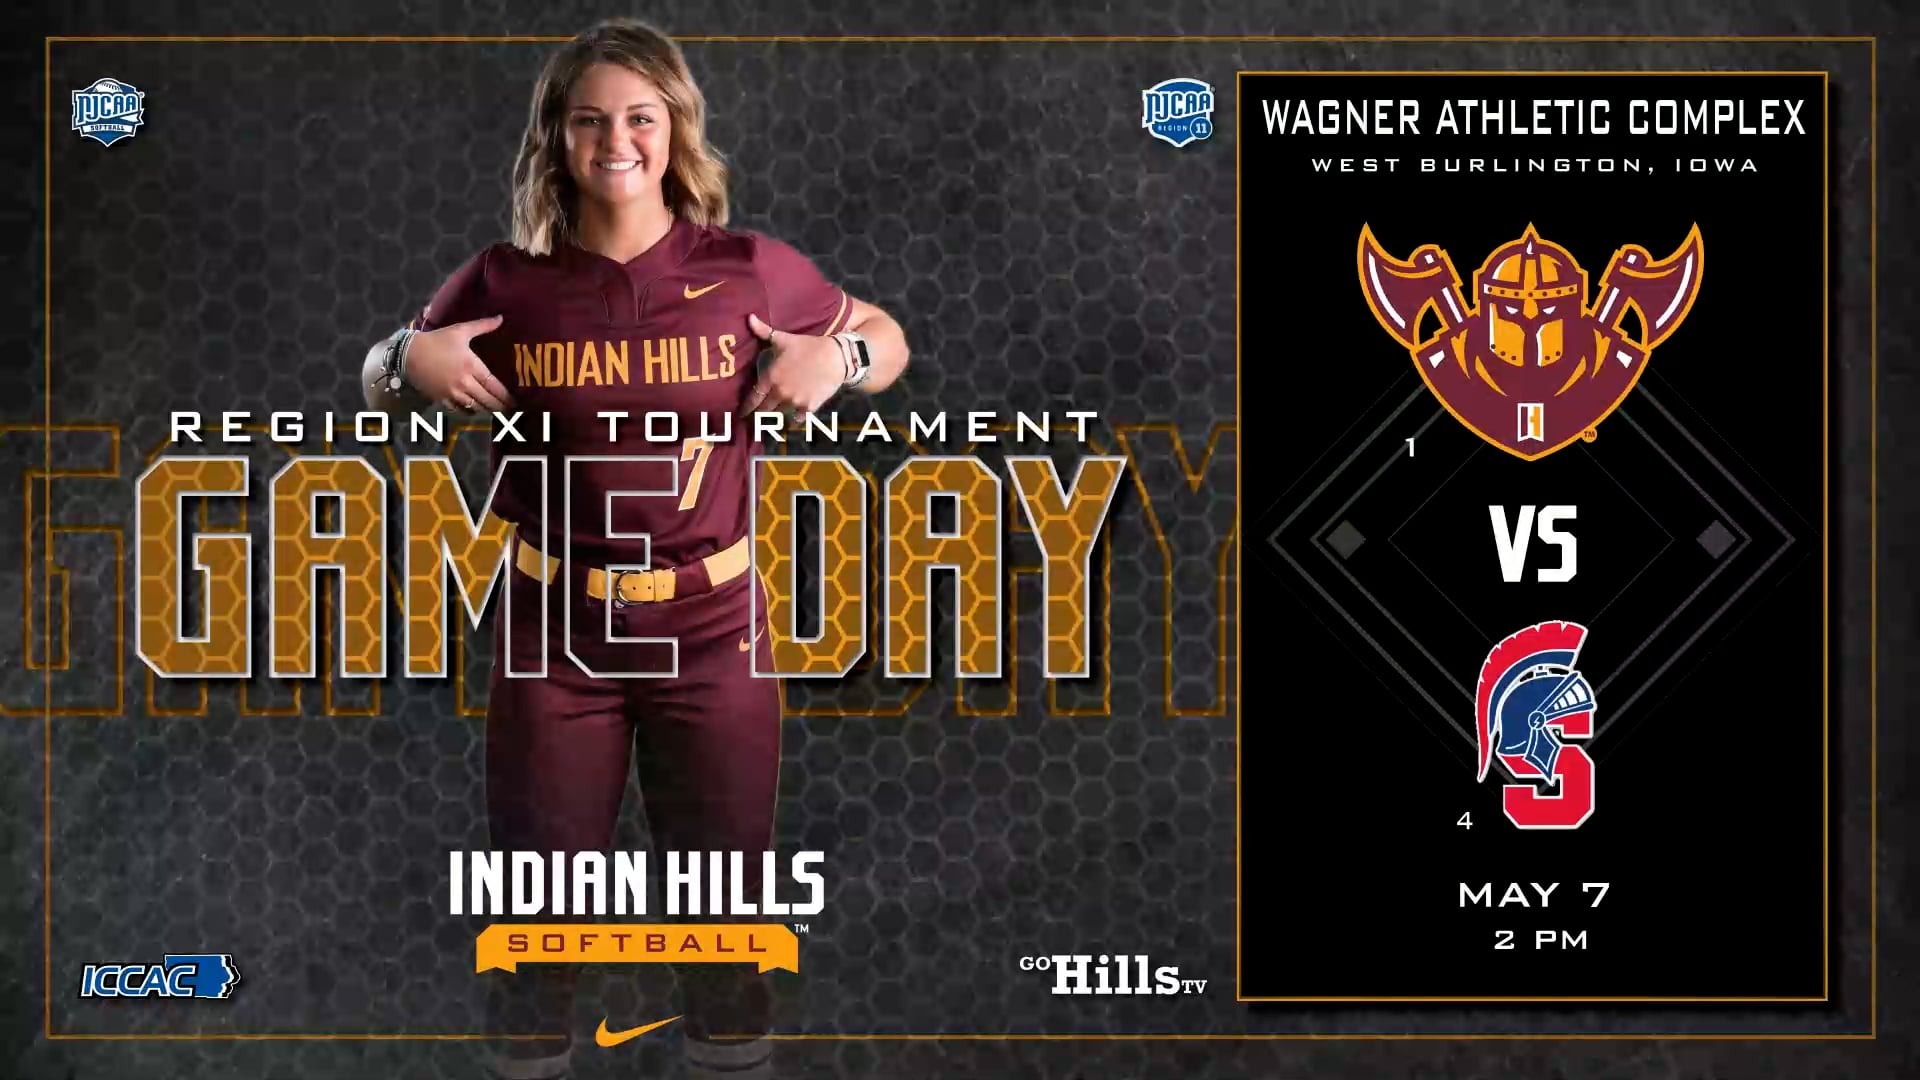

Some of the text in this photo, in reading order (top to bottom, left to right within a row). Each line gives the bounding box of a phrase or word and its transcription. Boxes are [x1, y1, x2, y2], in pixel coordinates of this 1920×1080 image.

[514, 334, 736, 387] INDIAN HILLS
[678, 434, 715, 511] 7
